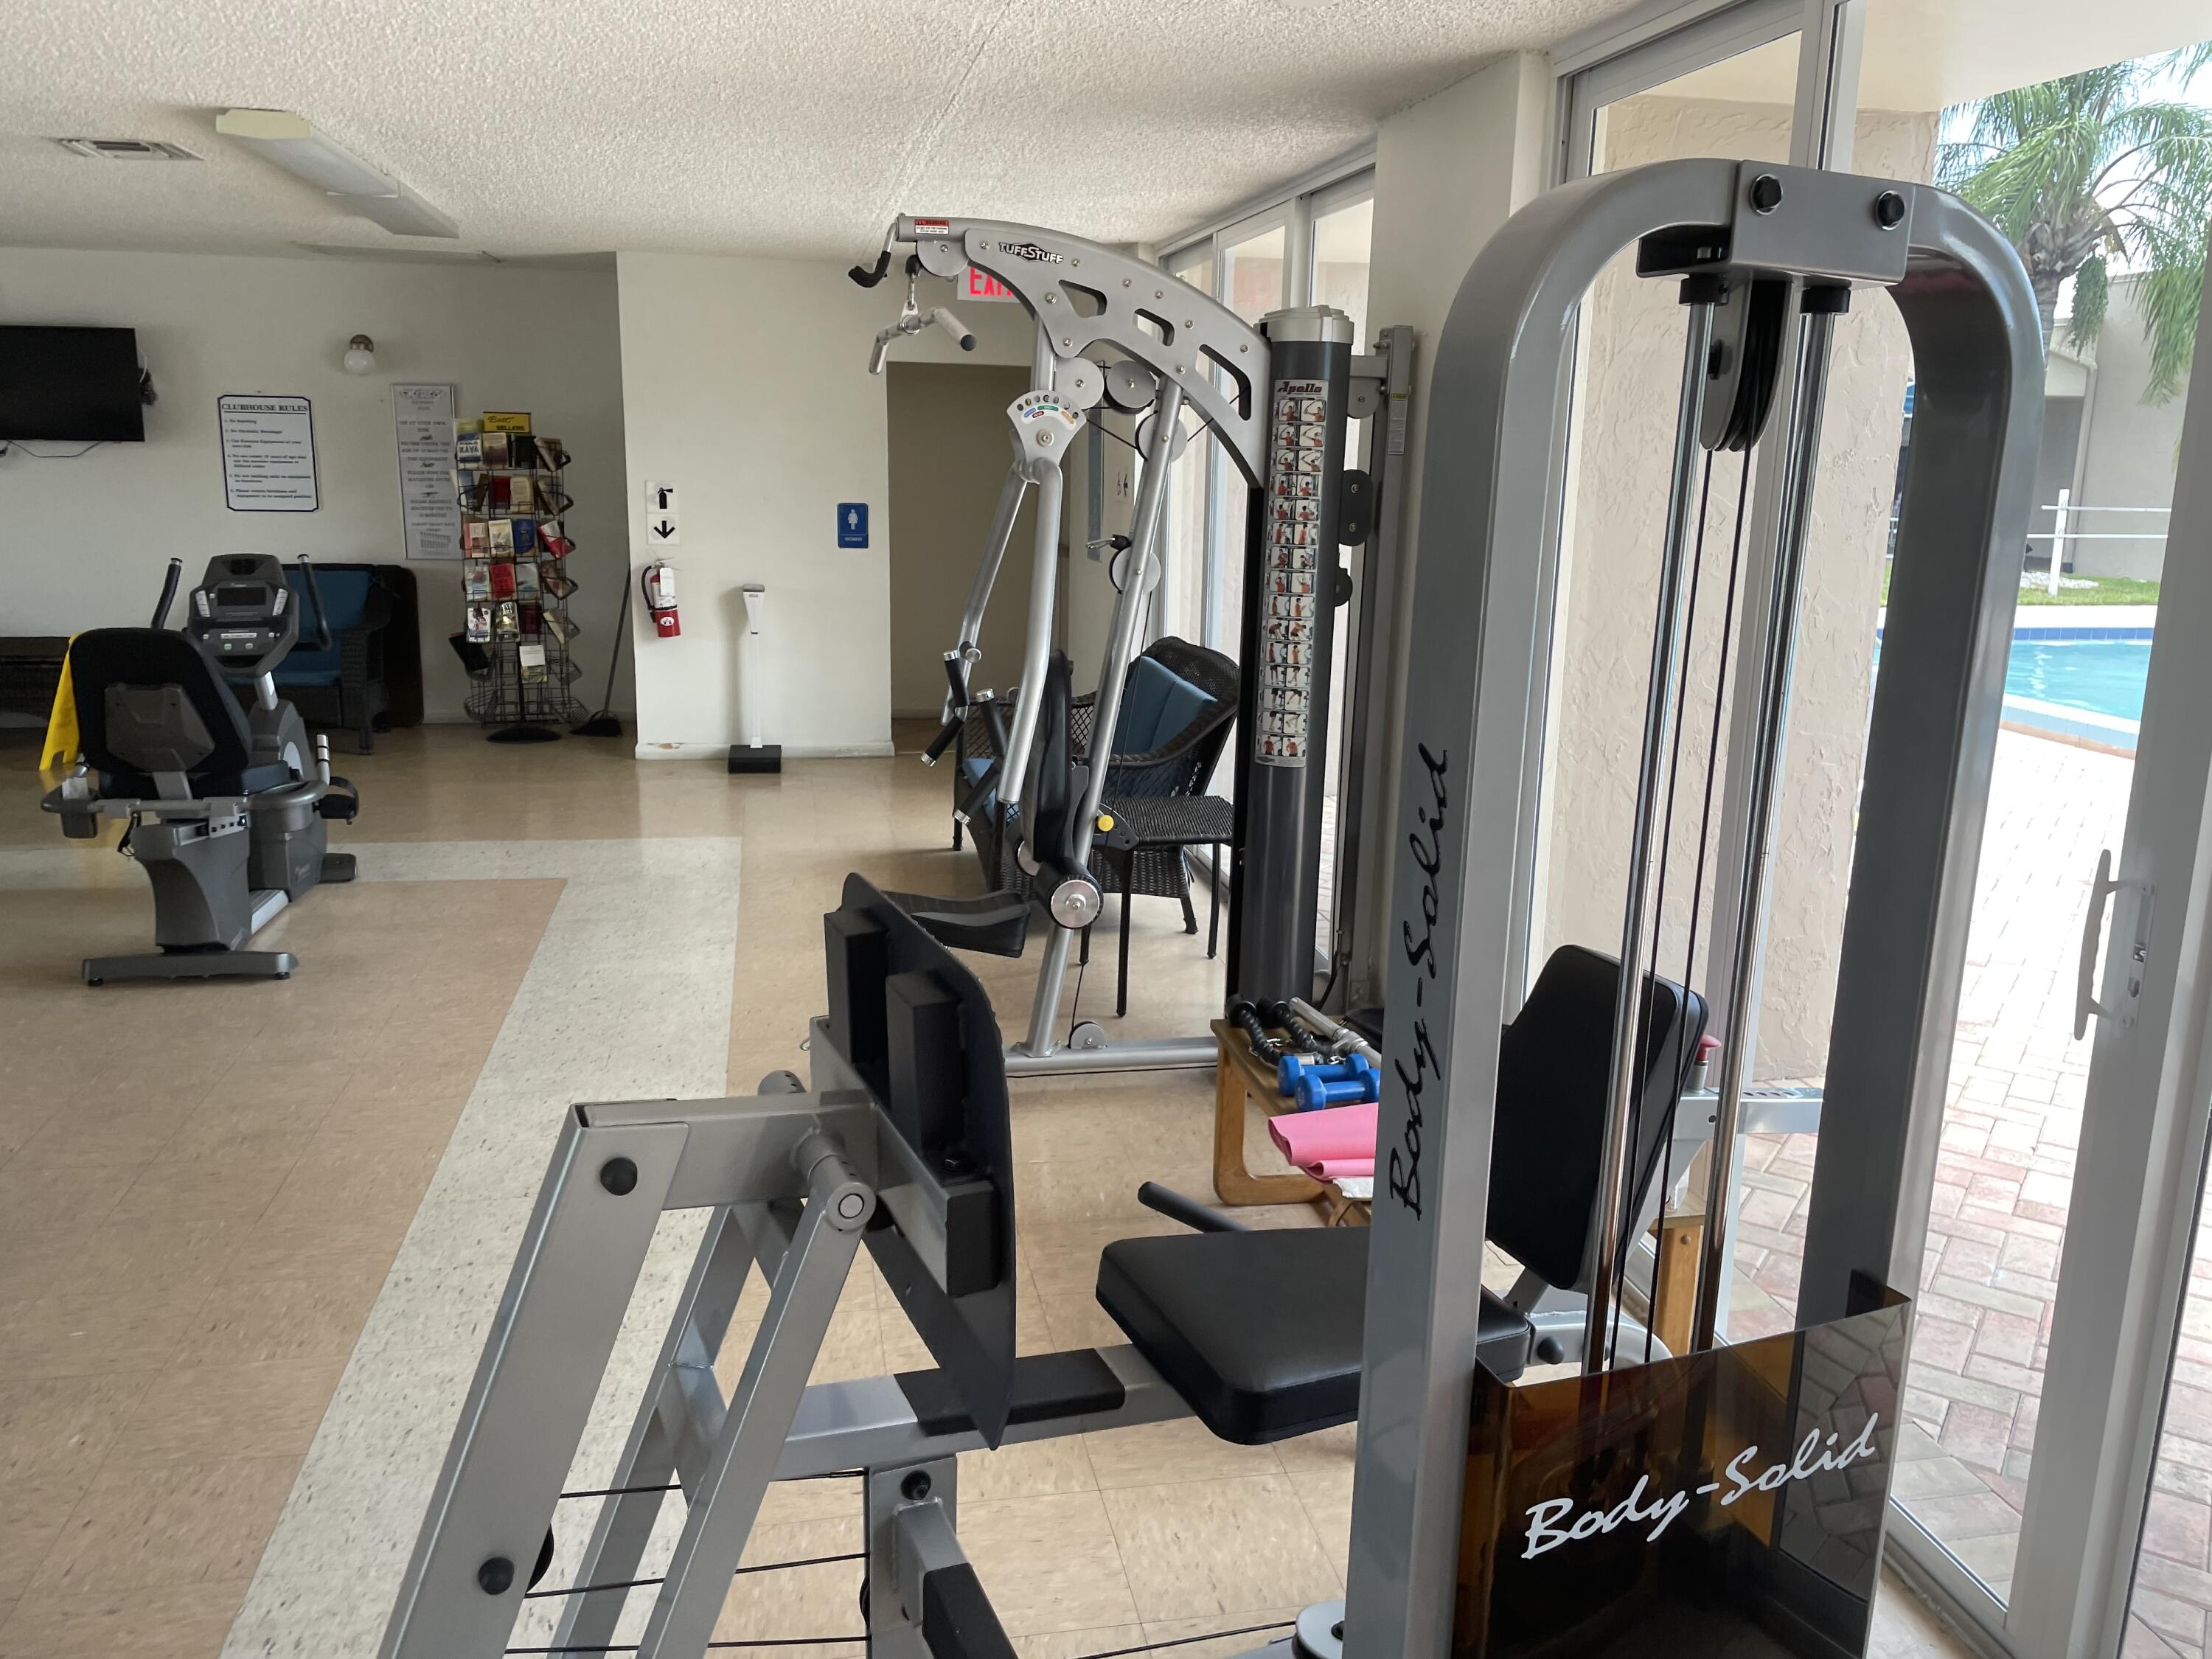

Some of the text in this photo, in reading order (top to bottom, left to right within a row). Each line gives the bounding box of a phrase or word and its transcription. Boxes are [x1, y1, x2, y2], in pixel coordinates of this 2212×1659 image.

[970, 265, 1012, 296] EX
[1277, 381, 1323, 394] Apollo
[221, 403, 276, 411] CLUBHOUSE
[1390, 742, 1449, 1222] Body-Solid
[1520, 1412, 1879, 1559] Body-Solid
